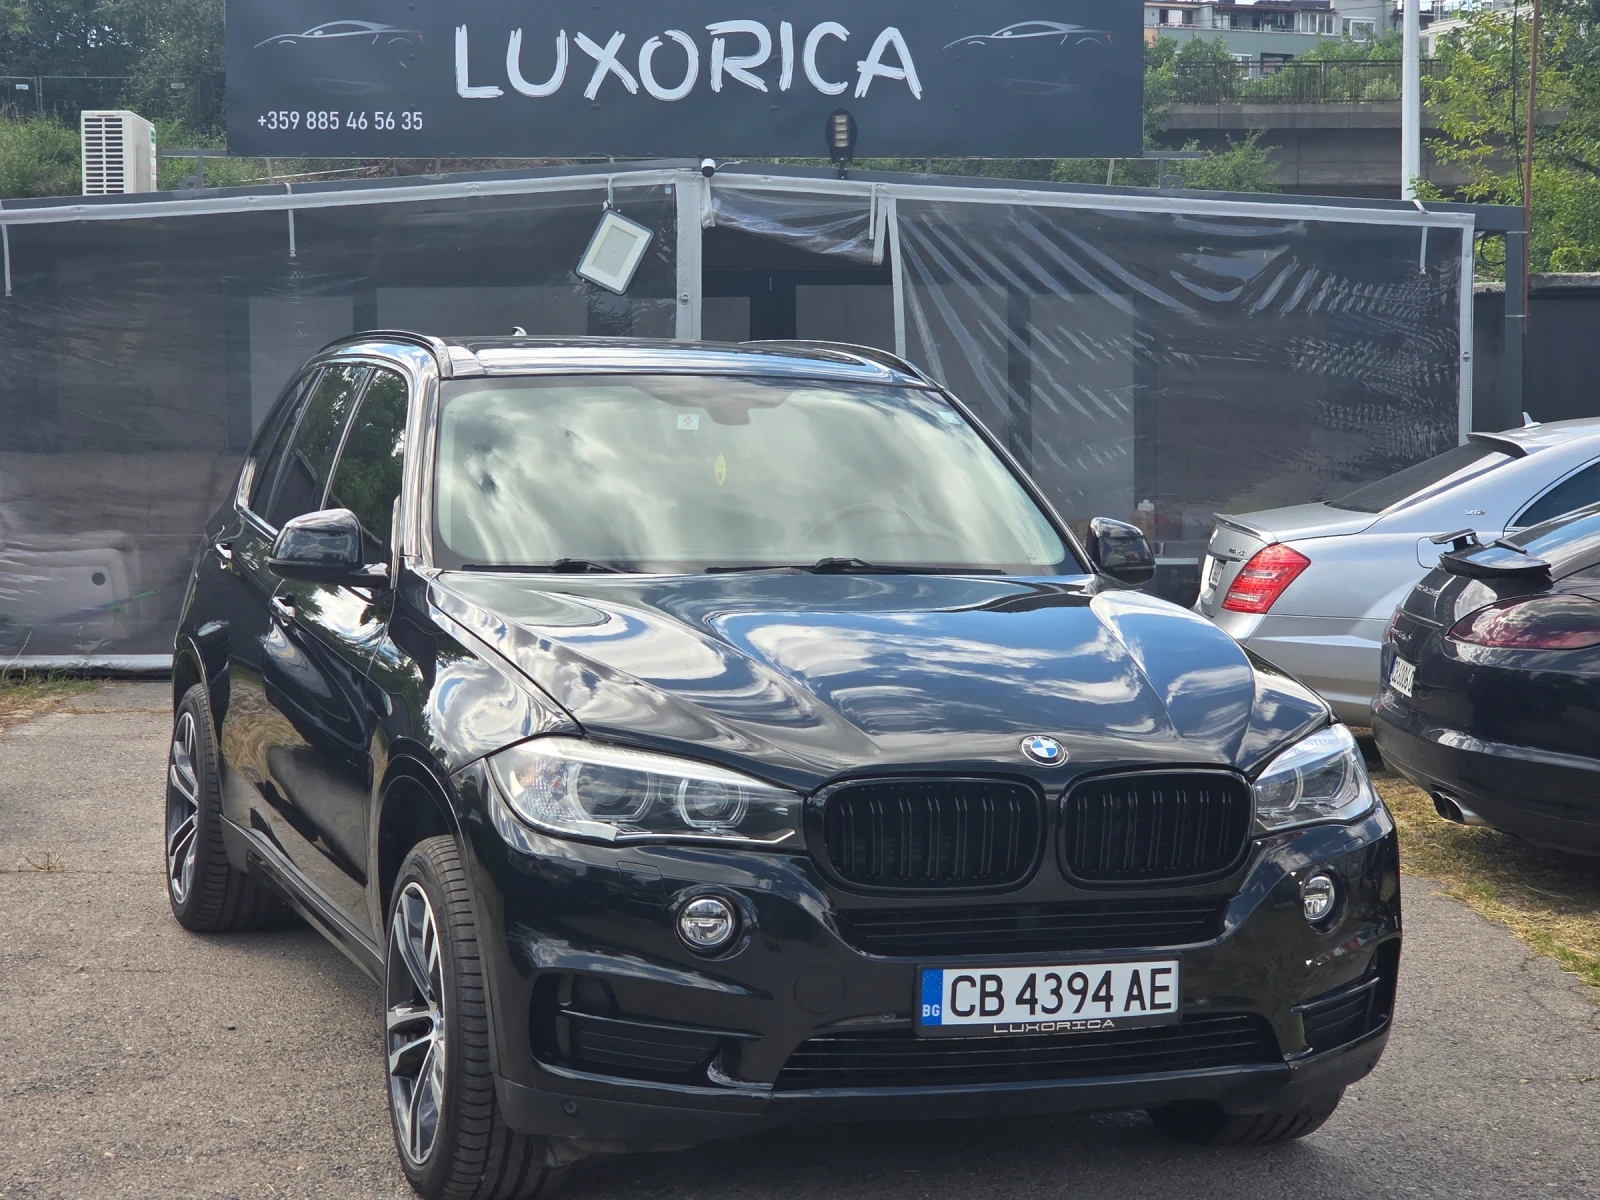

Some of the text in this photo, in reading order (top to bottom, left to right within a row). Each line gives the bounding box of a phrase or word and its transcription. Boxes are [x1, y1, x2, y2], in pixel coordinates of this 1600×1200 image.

[454, 19, 923, 101] LUXORICA
[257, 110, 423, 130] +359 885 46 56 35
[950, 967, 1172, 1017] CB 4394 AE
[922, 1004, 940, 1018] BG
[993, 1019, 1115, 1033] LUXORICA
